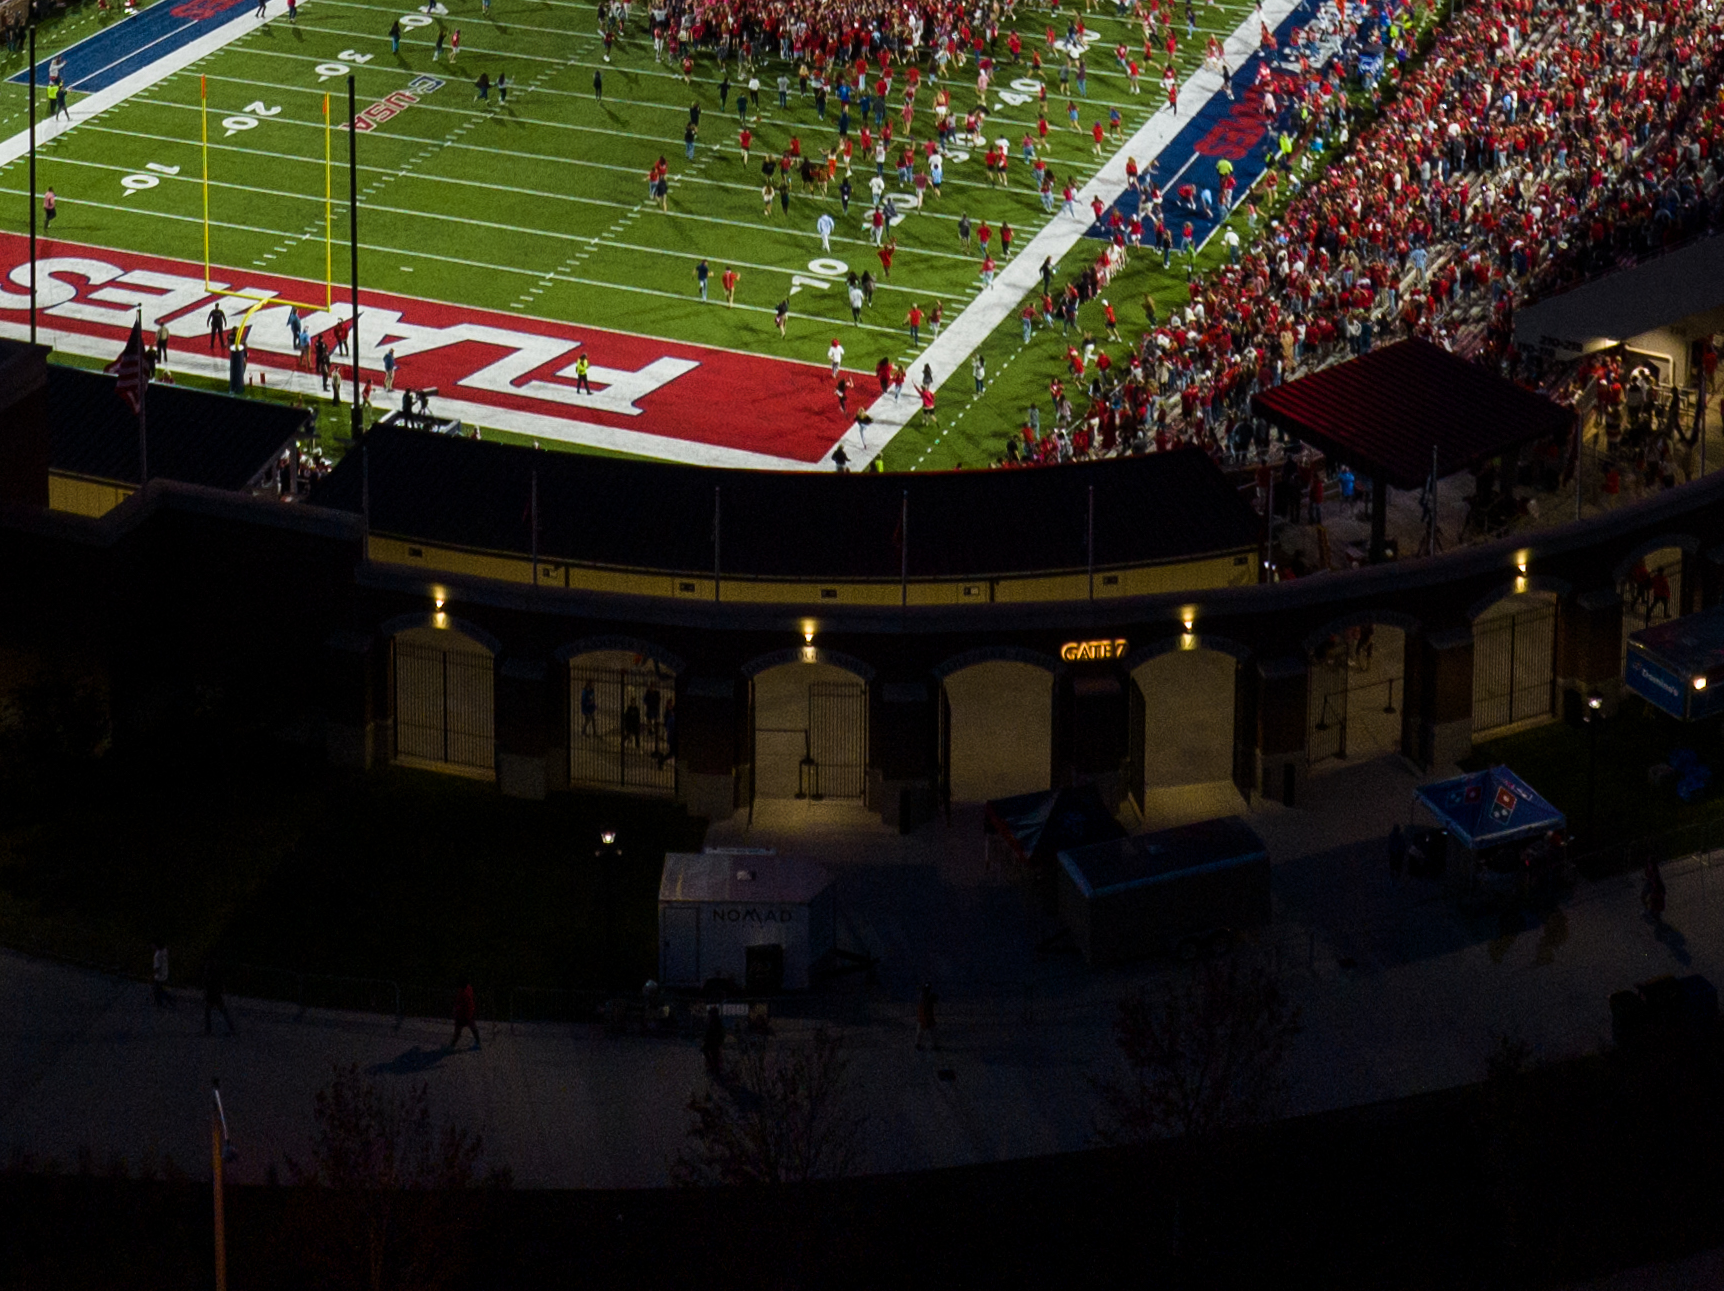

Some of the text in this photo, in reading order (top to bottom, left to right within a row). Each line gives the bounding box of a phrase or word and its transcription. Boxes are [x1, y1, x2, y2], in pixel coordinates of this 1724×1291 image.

[315, 49, 374, 77] 30
[222, 101, 281, 130] 20
[120, 162, 180, 190] 10
[790, 258, 849, 290] 10
[1060, 640, 1113, 662] GATE
[1115, 639, 1129, 658] 7
[712, 908, 792, 925] NOMAD
